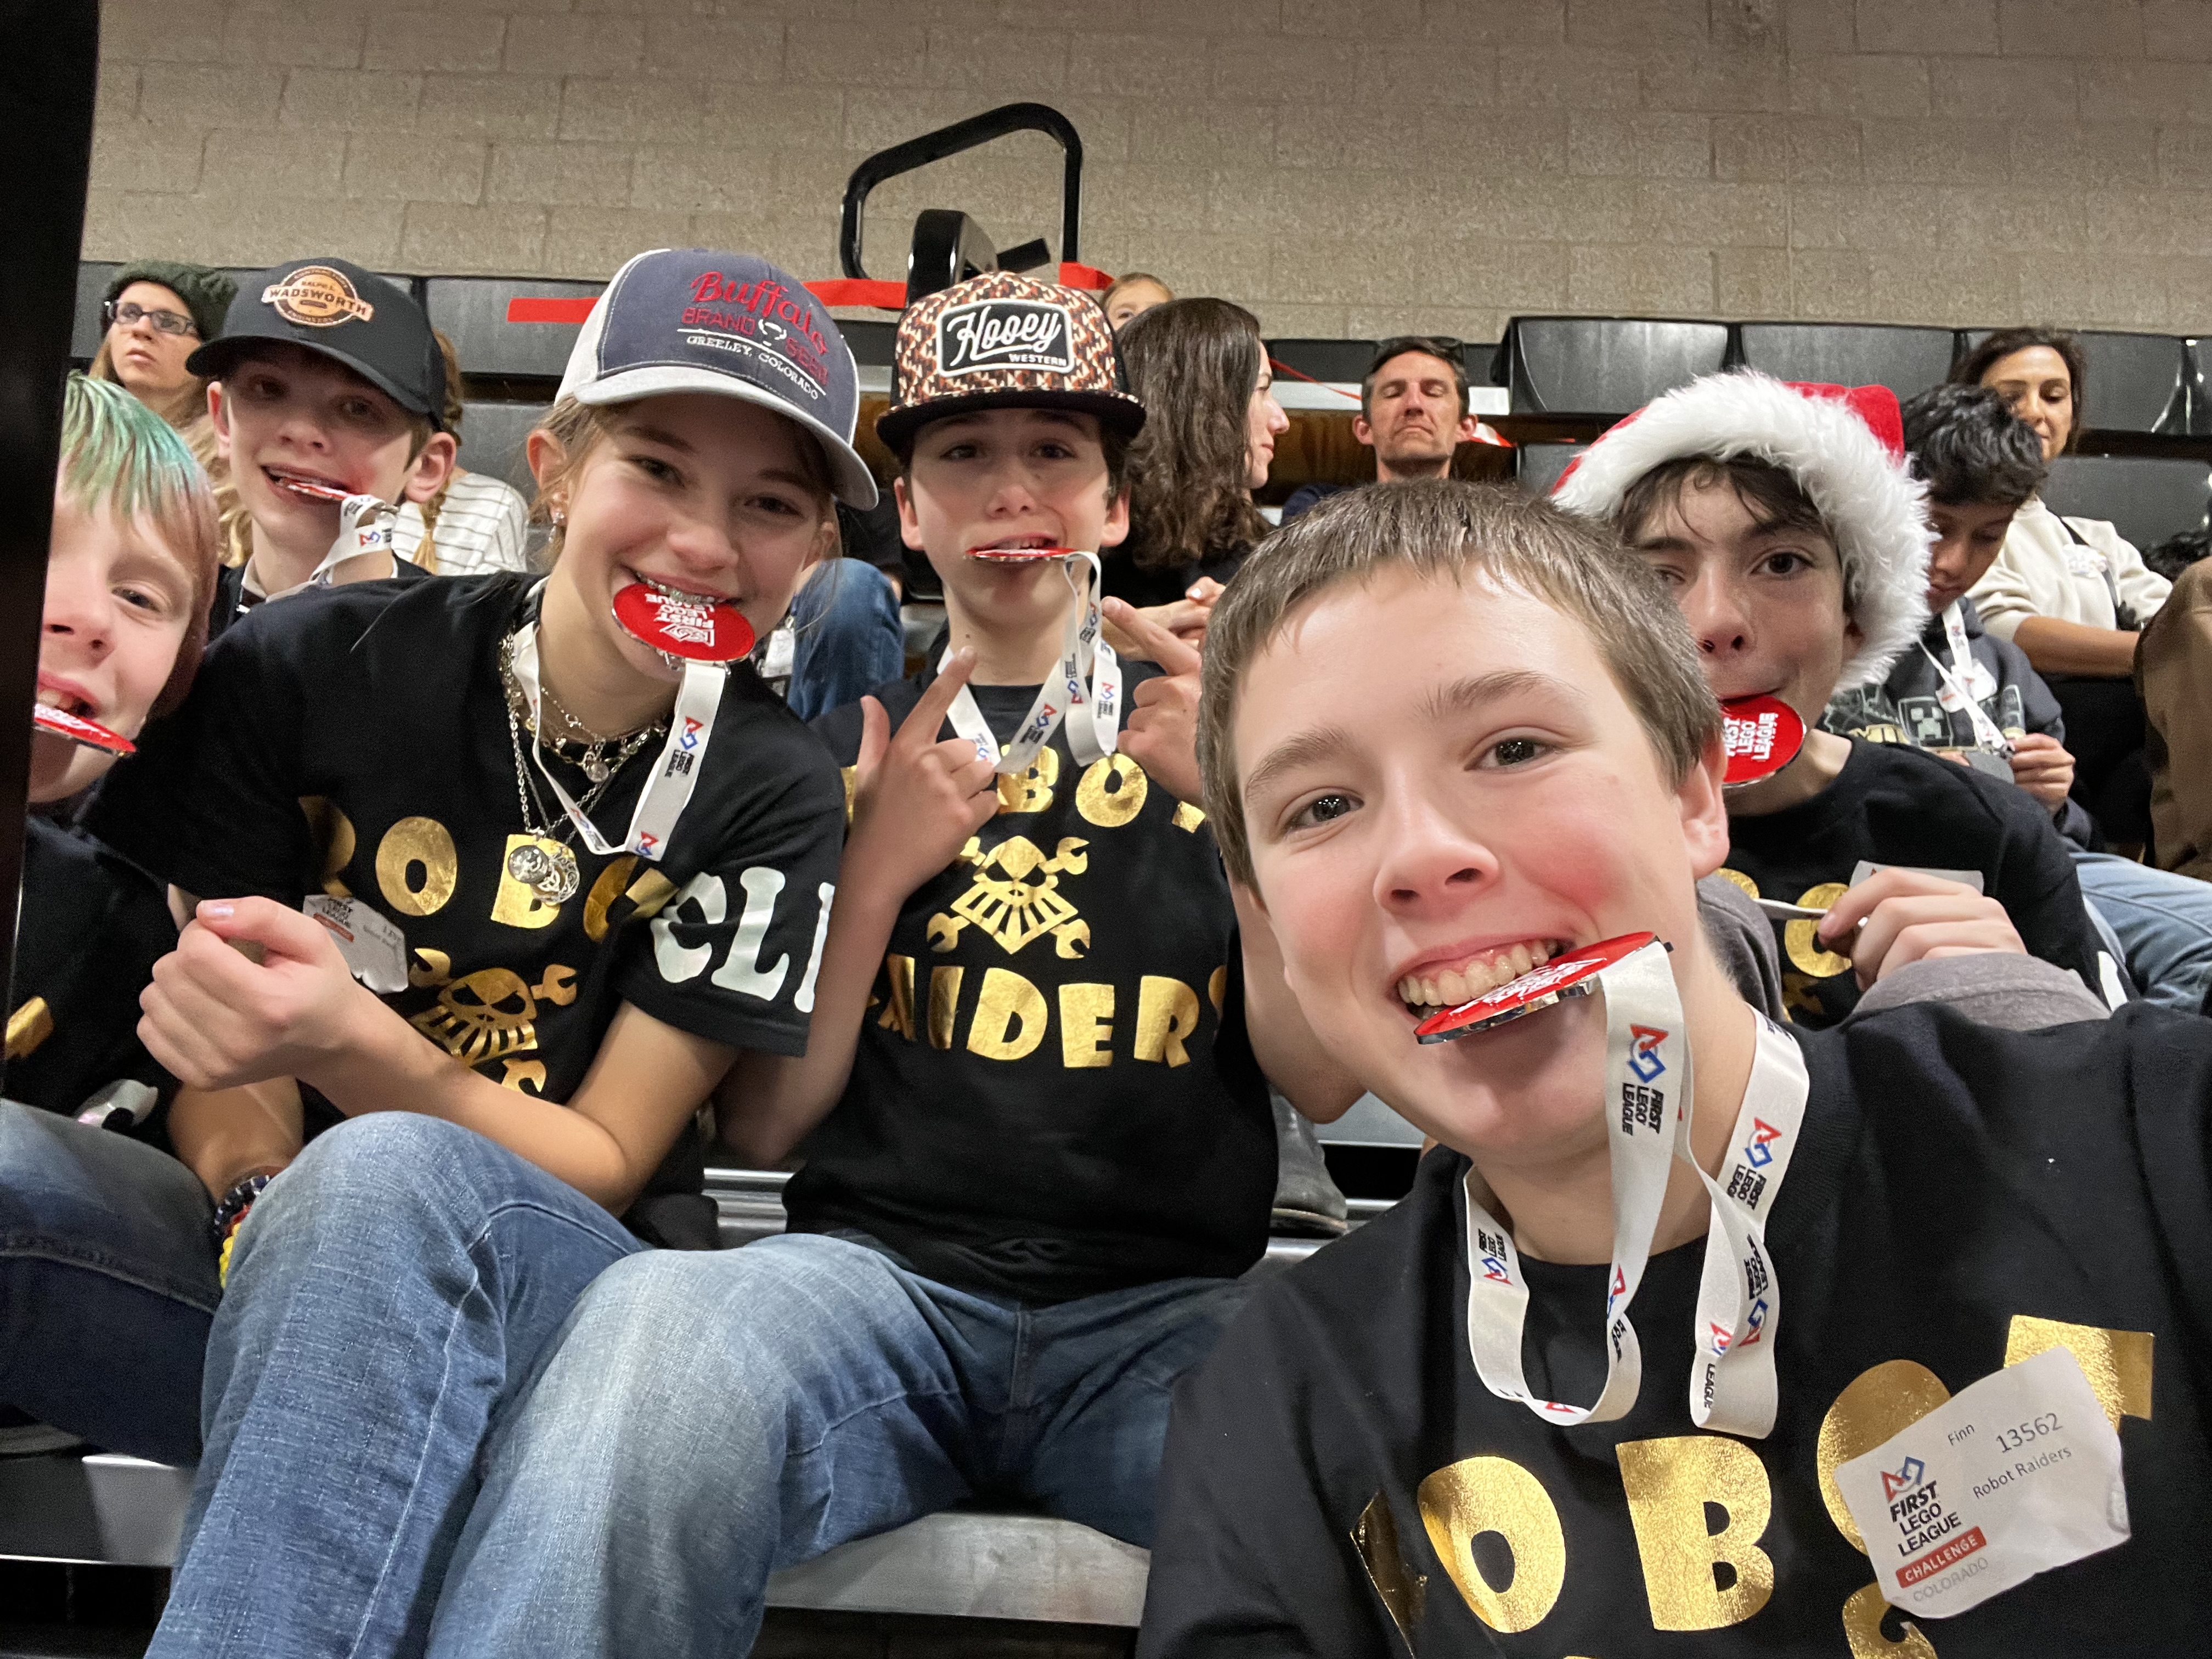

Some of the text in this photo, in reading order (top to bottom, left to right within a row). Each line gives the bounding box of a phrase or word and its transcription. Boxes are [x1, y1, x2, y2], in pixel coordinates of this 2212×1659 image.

[269, 289, 366, 315] WADSWORTH
[681, 307, 756, 336] BRAND
[690, 271, 828, 355] Buffalo
[947, 306, 1062, 366] Hooey
[758, 353, 819, 399] COLORADO
[1009, 354, 1067, 366] WESTERN
[653, 613, 714, 629] FIRST
[1736, 720, 1756, 755] LEGO
[1751, 713, 1777, 761] LEAGUE
[867, 953, 1228, 1069] AIDER
[1622, 1082, 1634, 1136] LEAGUE
[1637, 1085, 1649, 1126] LEGO
[1649, 1088, 1664, 1134] FIRST
[1728, 1164, 1746, 1198] LEAG
[1737, 1169, 1756, 1201] LEGO
[1747, 1174, 1767, 1211] FIRST
[1948, 1423, 1976, 1447] Finn
[1996, 1412, 2064, 1454] 13562
[1973, 1445, 2073, 1499] Robot Raiders
[1890, 1481, 1938, 1522] FIRST
[1899, 1502, 1942, 1536] LEGO
[1897, 1512, 1962, 1557] LEAGUE
[1905, 1534, 1979, 1583] CHALLENGE
[1913, 1558, 1989, 1602] COLORADO
